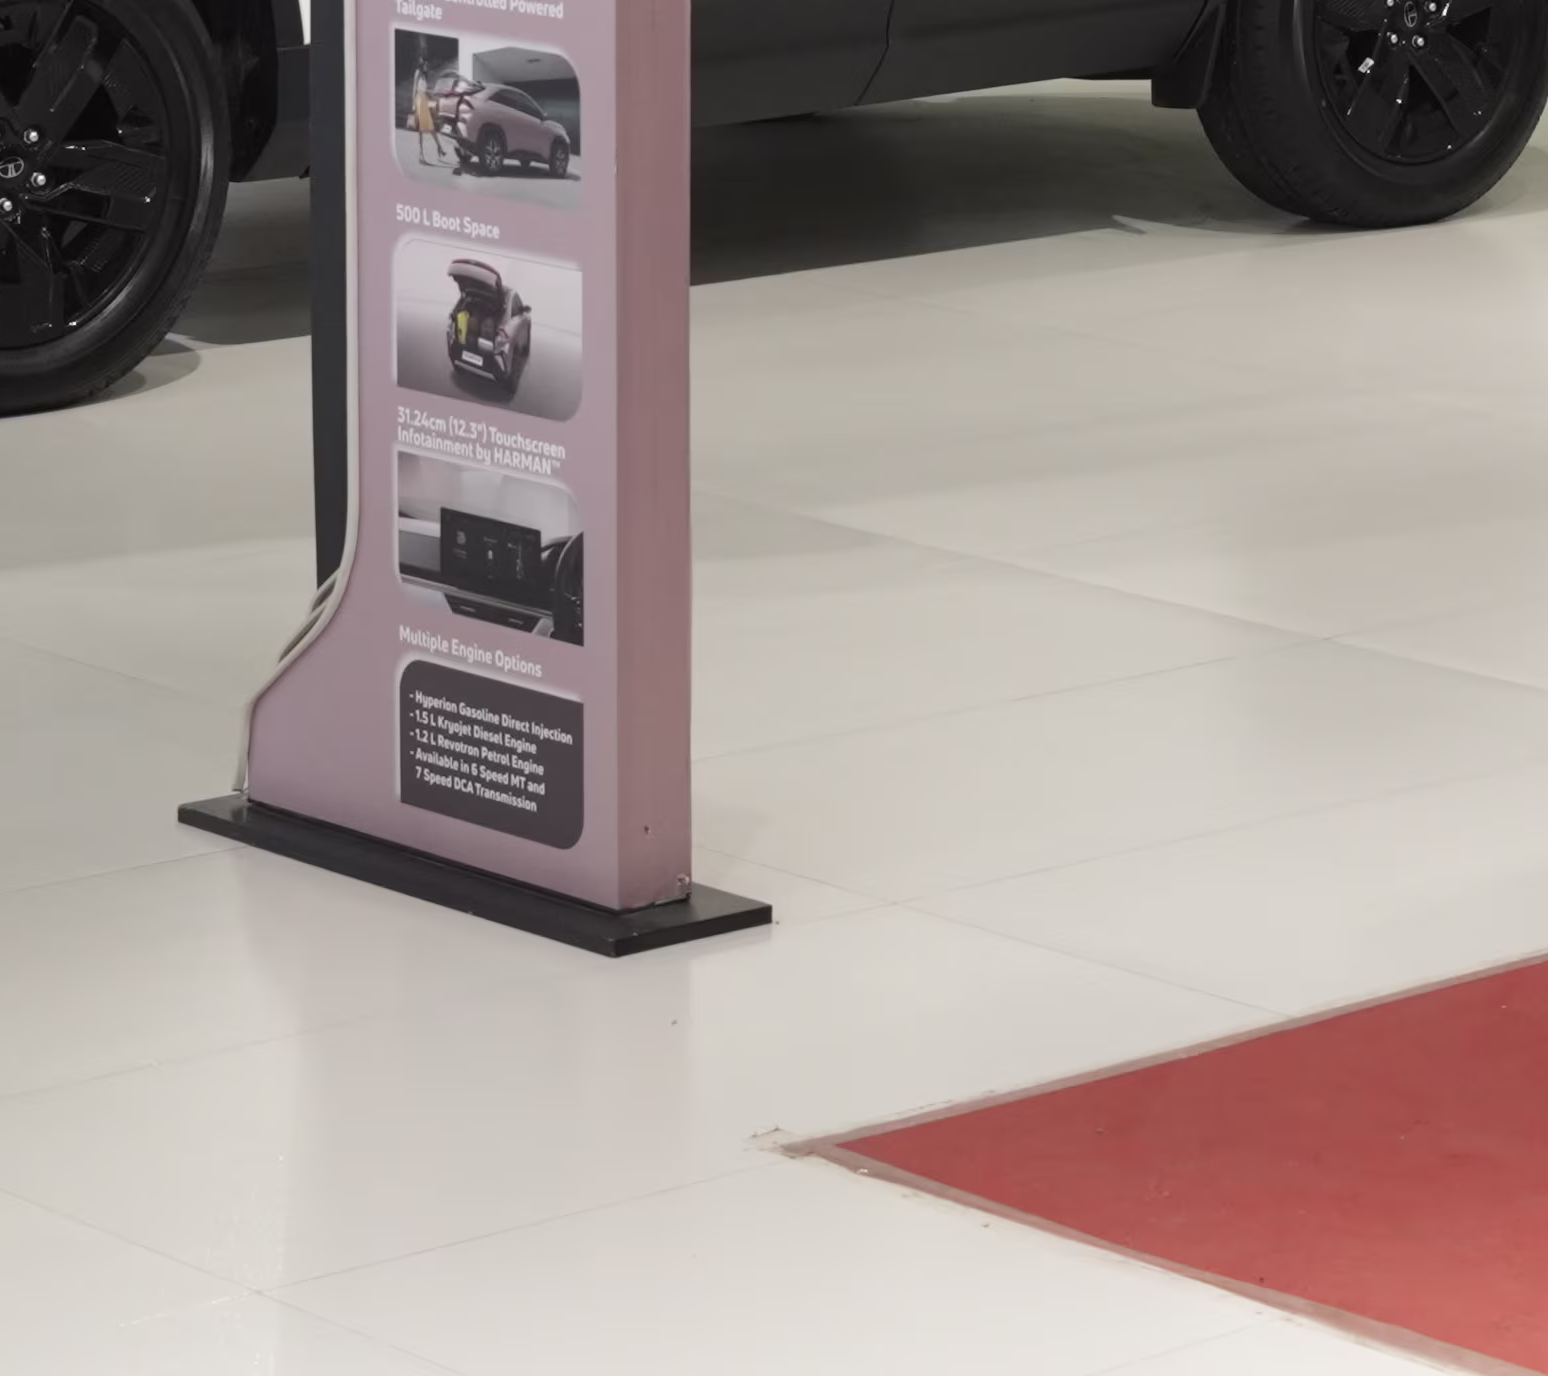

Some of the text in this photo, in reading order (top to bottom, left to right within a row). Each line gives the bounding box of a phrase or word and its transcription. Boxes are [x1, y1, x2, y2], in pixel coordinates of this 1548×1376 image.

[396, 203, 500, 239] 500 L Boot Space
[397, 406, 446, 432] 31.24cm
[489, 426, 566, 460] Touchscreen
[398, 426, 473, 458] Infotainment
[476, 446, 491, 465] by
[399, 624, 542, 678] Multiple Engine Options
[415, 690, 573, 745] Hyperion Gasoline Direct Injection
[415, 710, 537, 755] 1.5 L Kryojet Diesel Engine
[415, 729, 544, 776] 1.2 L Revotron Petrol Engine
[415, 748, 546, 796] Available in 6 Speed MT and
[415, 766, 538, 812] 7 Speed DCA Transmission
